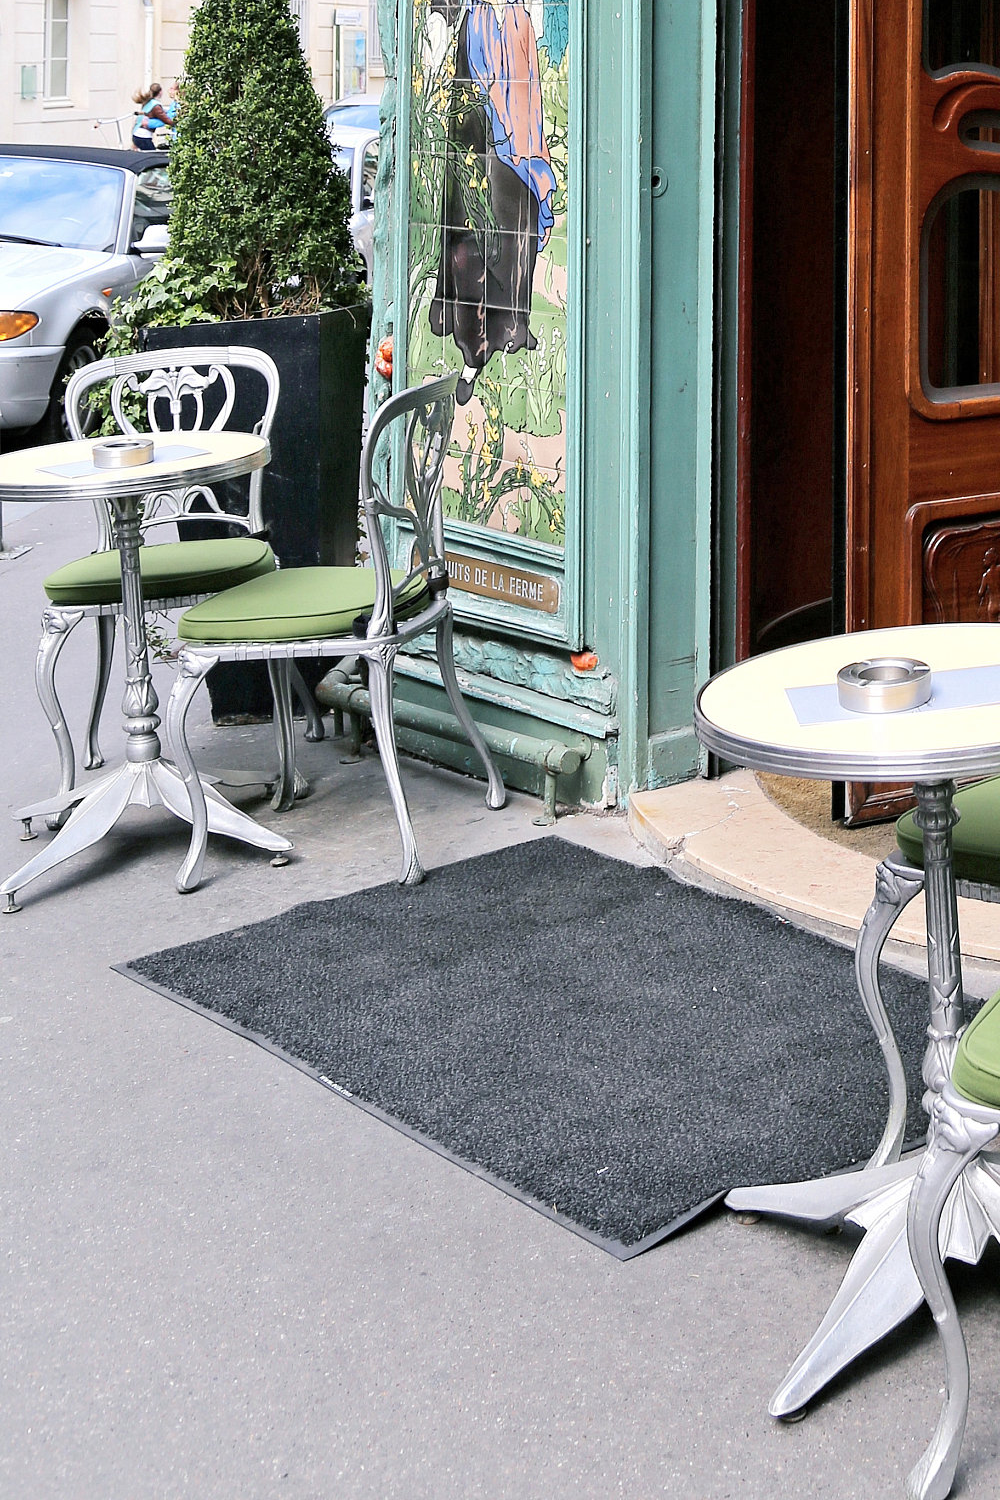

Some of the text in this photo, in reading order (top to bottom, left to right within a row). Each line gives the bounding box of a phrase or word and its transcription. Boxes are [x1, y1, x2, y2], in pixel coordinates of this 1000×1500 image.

[473, 567, 488, 588] DE
[491, 571, 505, 593] LA
[509, 576, 545, 602] FERME
